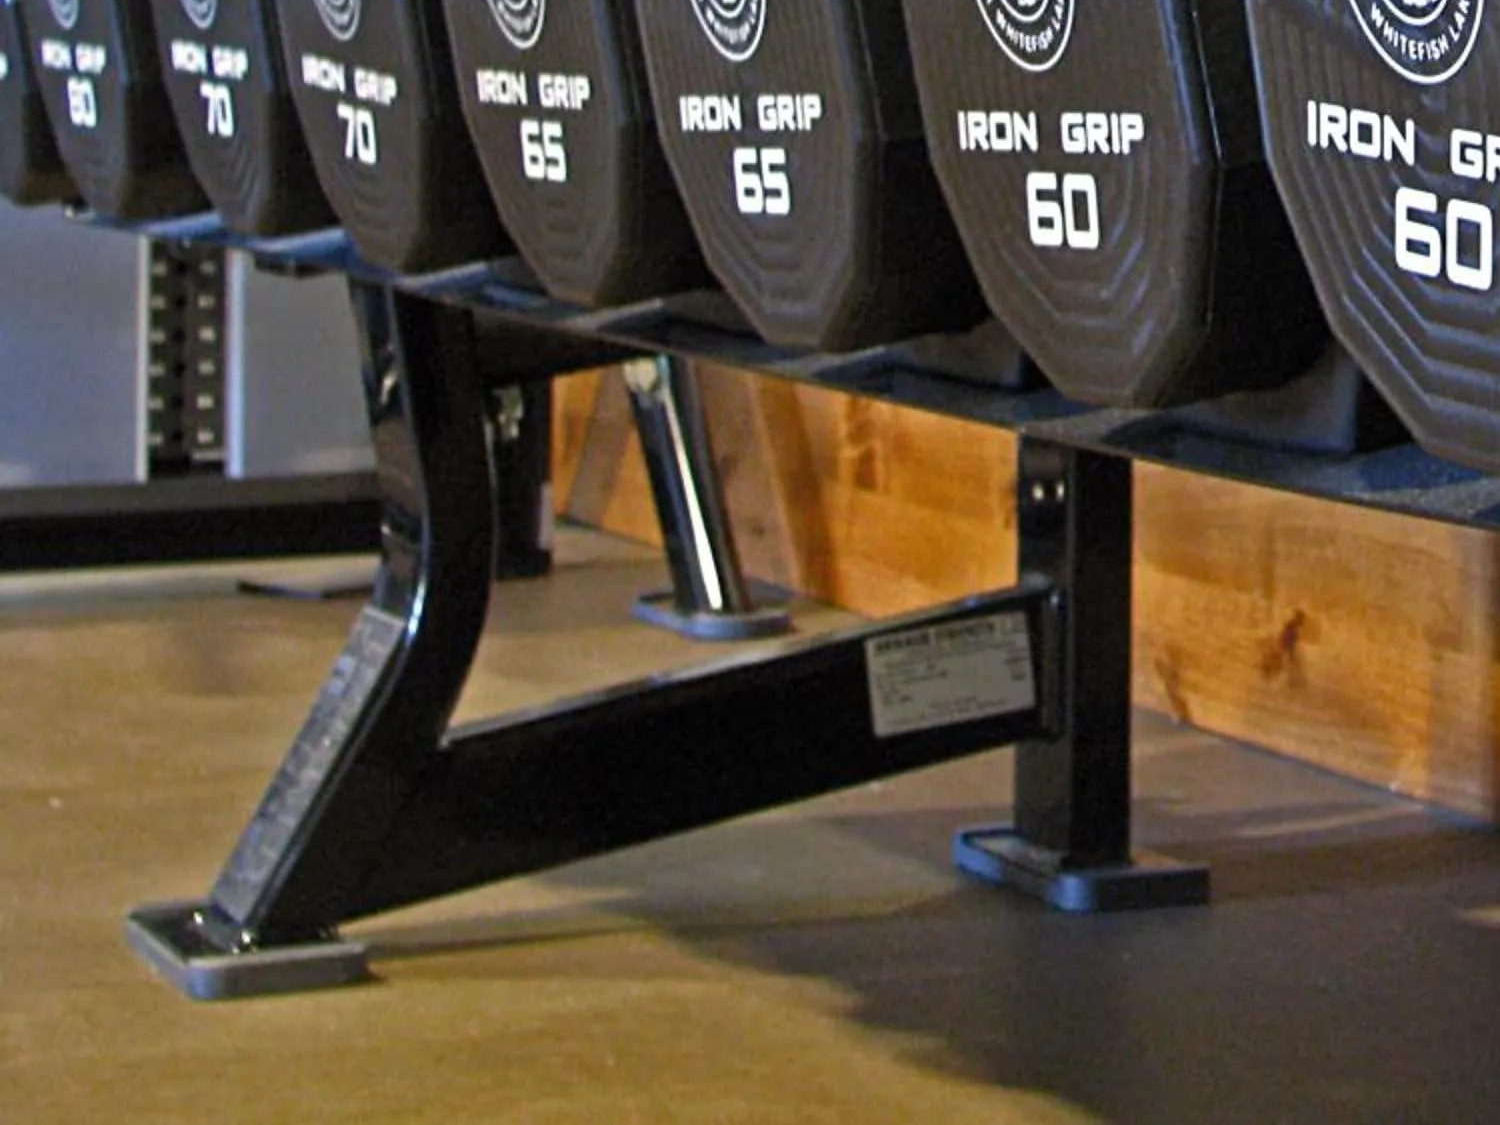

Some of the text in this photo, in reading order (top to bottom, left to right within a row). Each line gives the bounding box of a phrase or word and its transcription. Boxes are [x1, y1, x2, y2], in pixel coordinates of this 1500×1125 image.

[1370, 2, 1449, 60] WHITEFISH
[200, 82, 234, 137] 70
[302, 56, 397, 105] IRON GRIP
[477, 70, 590, 110] IRON GRIP
[337, 103, 377, 164] 70
[679, 94, 821, 131] IRON GRIP
[957, 111, 1144, 155] IRON GRIP
[1307, 100, 1415, 166] IRON
[520, 119, 567, 182] 65
[733, 147, 790, 215] 65
[1026, 171, 1100, 250] 60
[1395, 186, 1493, 291] 60
